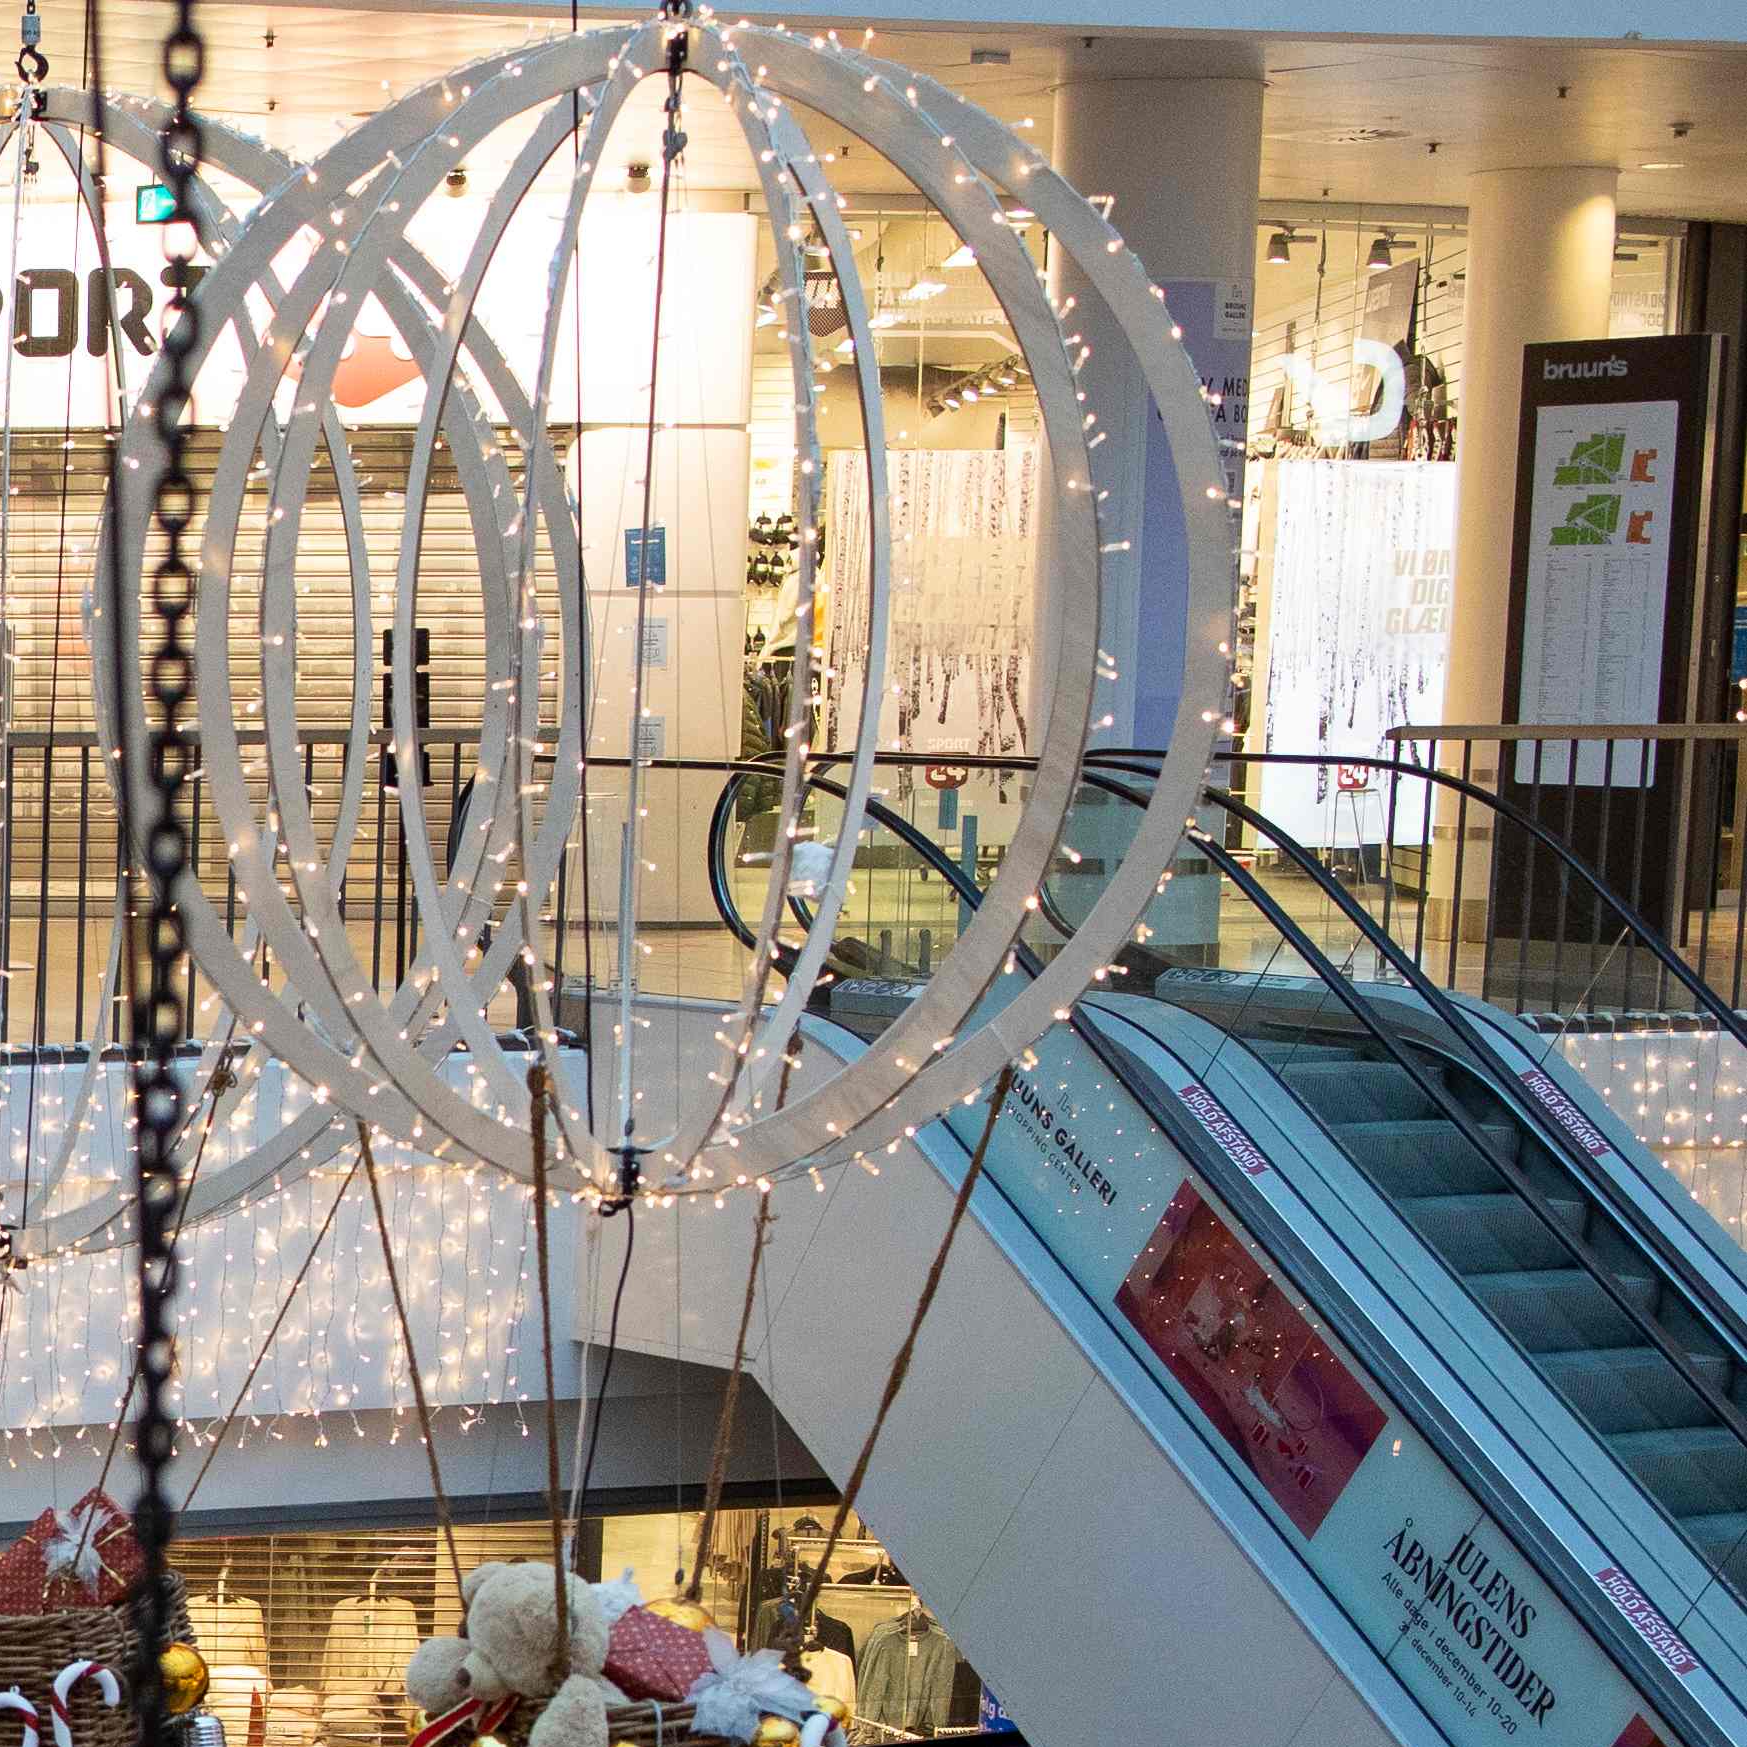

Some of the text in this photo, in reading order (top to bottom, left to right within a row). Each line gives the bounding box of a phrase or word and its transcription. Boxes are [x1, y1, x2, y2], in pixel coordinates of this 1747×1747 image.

[1188, 1091, 1259, 1170] HOLD AFSTAND
[1527, 1076, 1600, 1150] HOLD AFSTAND
[1054, 1127, 1119, 1207] GALLERI
[1381, 1516, 1557, 1729] ÅBNINGSTIDER
[1443, 1533, 1538, 1639] JULENS
[1605, 1575, 1686, 1667] HOLD AFSTAND
[1381, 1571, 1405, 1599] Alle
[1403, 1596, 1430, 1632] dage
[1434, 1630, 1488, 1701] december
[1485, 1696, 1520, 1736] 10-20
[1410, 1638, 1455, 1692] december
[1451, 1686, 1477, 1719] 10-14
